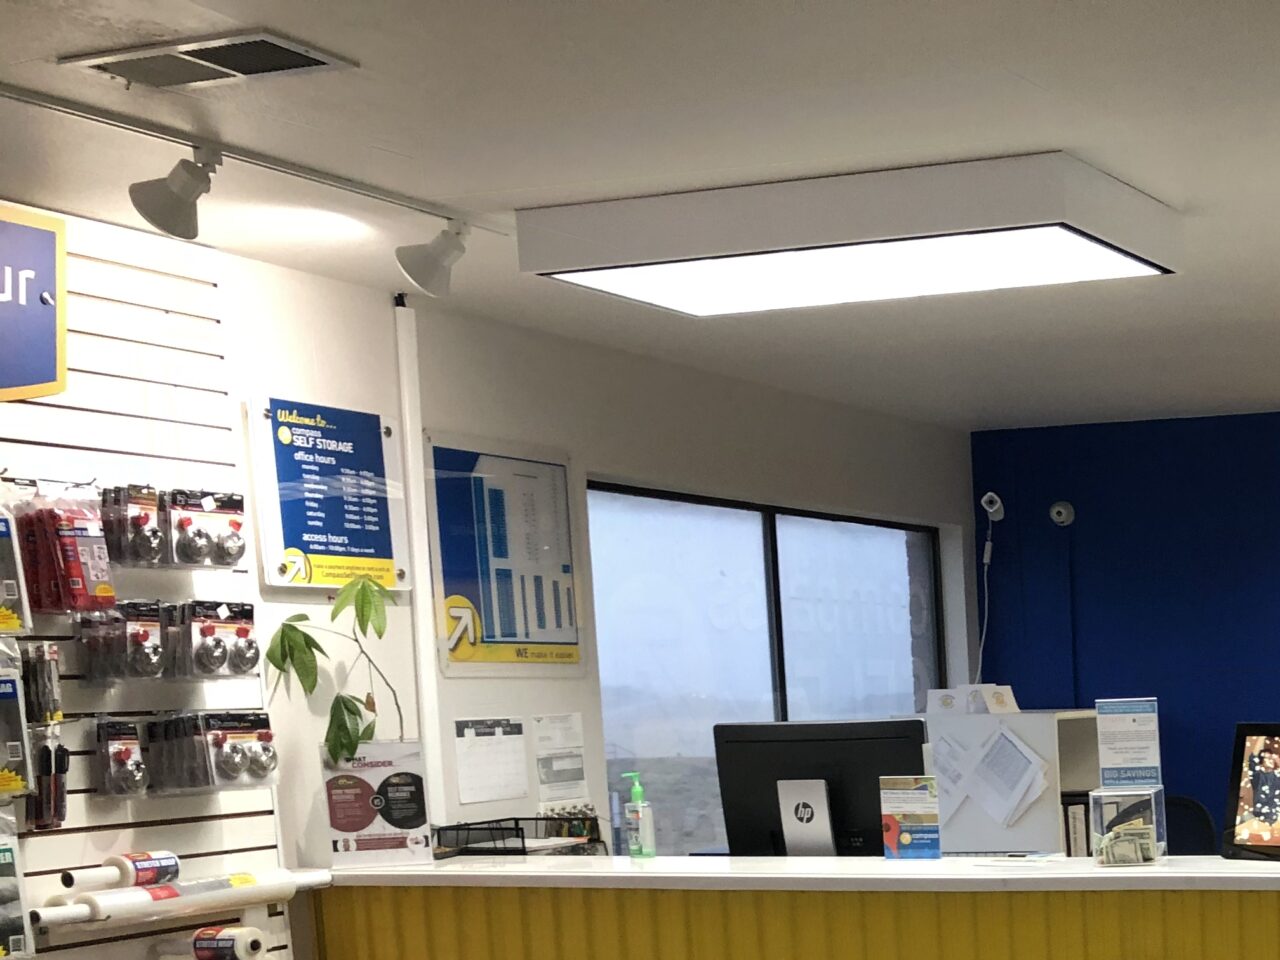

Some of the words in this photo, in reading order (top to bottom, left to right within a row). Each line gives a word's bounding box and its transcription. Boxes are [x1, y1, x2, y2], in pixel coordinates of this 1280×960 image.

[291, 427, 322, 438] compass
[292, 435, 315, 448] SELF
[316, 438, 354, 453] STORAGE
[293, 451, 315, 461] office
[315, 452, 337, 465] hours
[302, 533, 328, 542] access
[328, 533, 349, 544] hours
[1103, 769, 1119, 779] BIG
[1120, 768, 1157, 778] SAVINGS
[796, 801, 813, 824] hp
